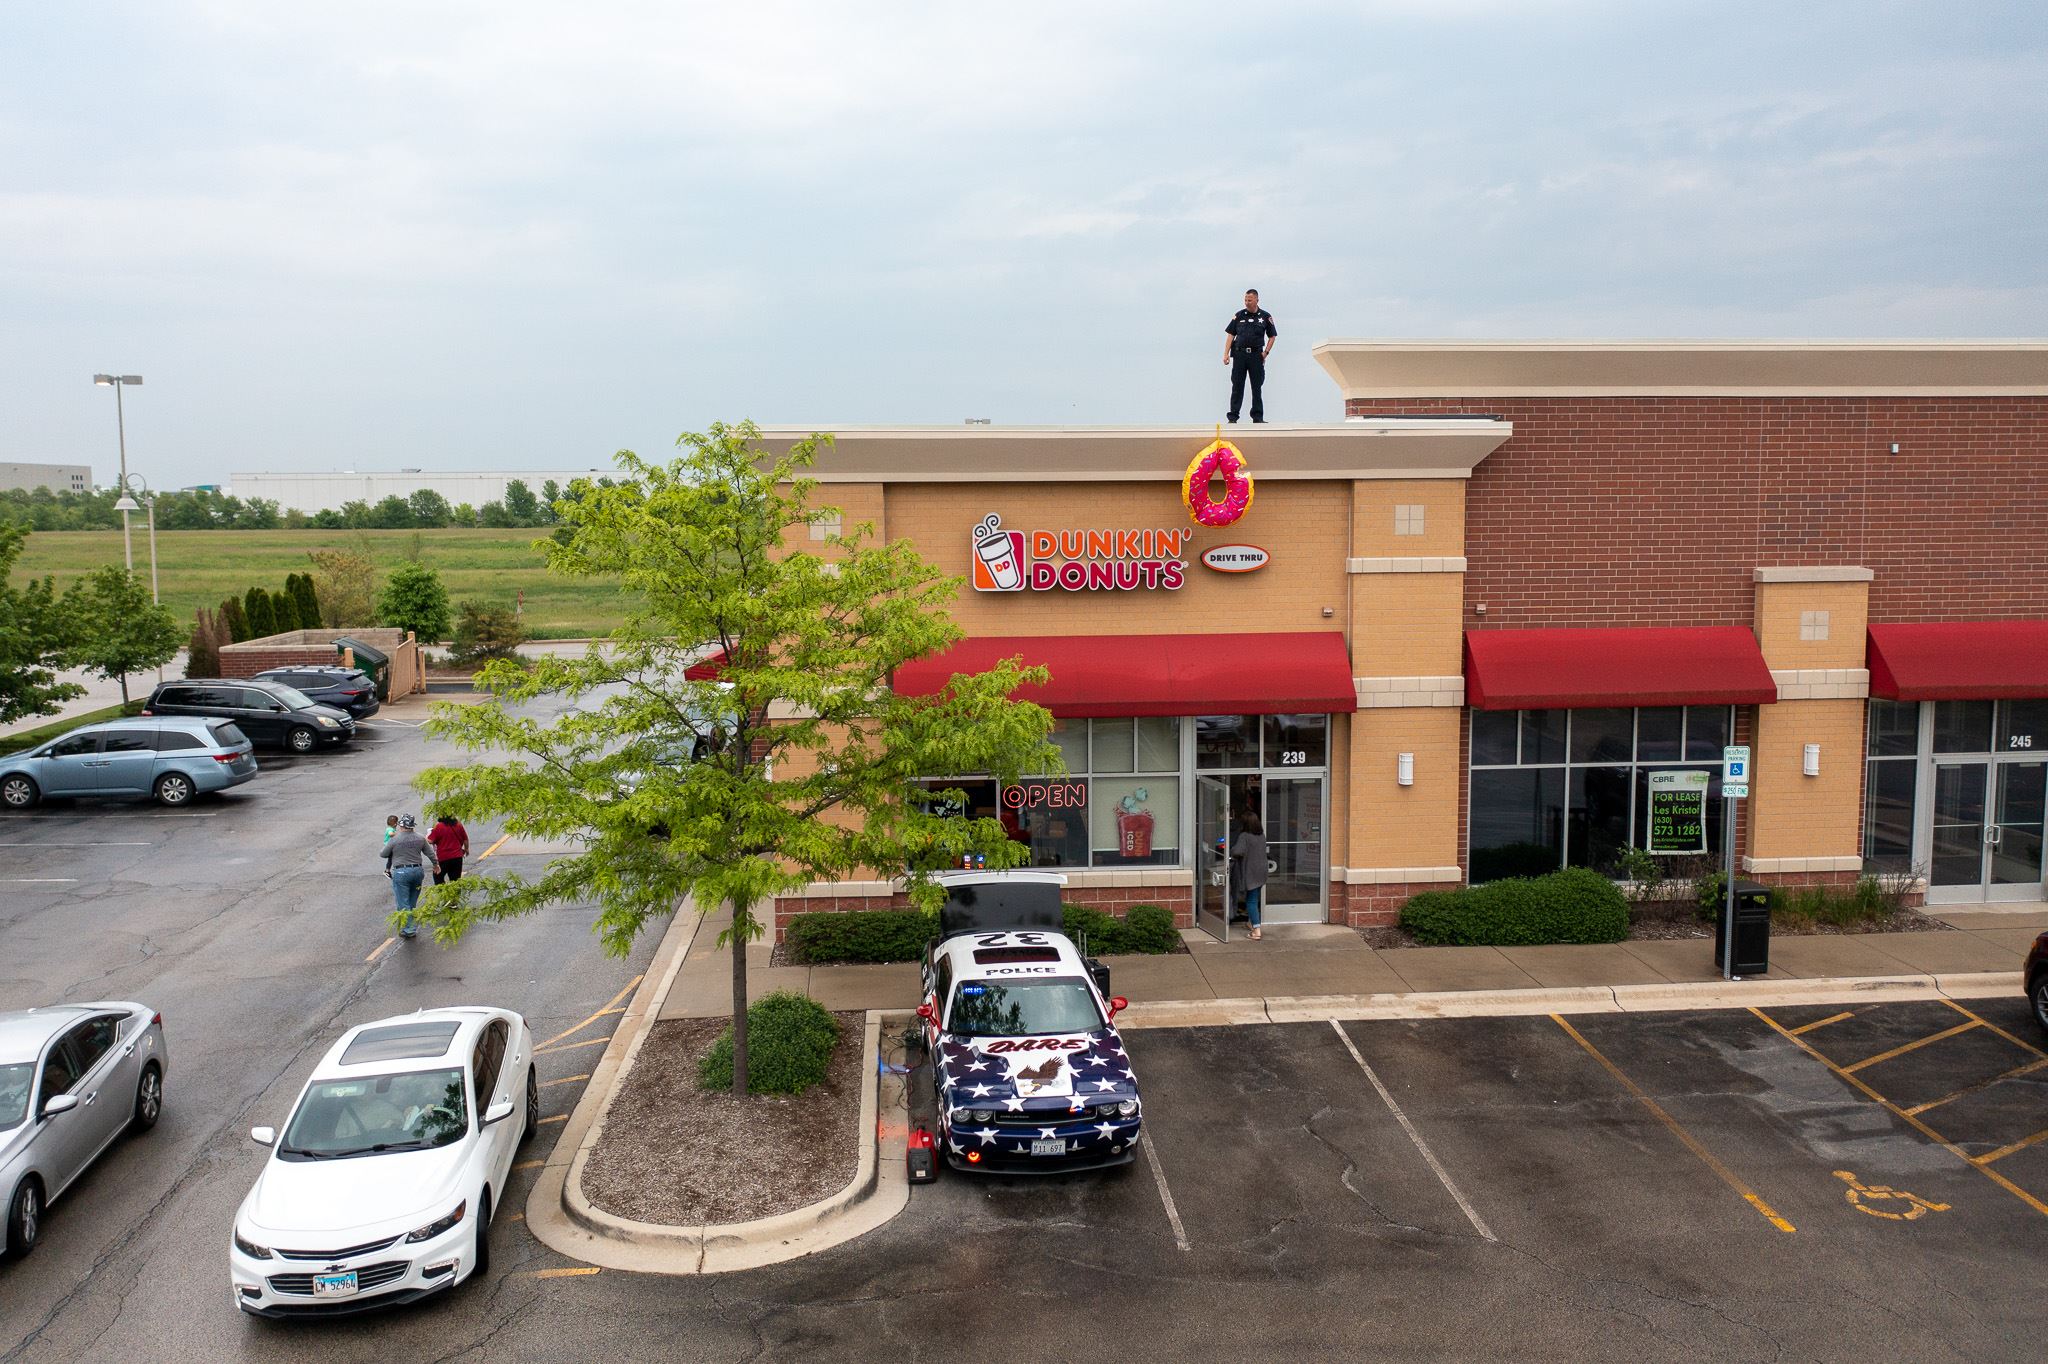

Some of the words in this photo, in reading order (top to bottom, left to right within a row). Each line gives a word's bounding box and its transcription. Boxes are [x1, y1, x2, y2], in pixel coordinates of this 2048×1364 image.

[1032, 528, 1192, 560] DUNKIN'
[1210, 554, 1237, 562] DRIVE
[1240, 554, 1263, 562] THRU
[1032, 560, 1185, 591] DONUTS
[2010, 735, 2032, 748] 245
[1282, 751, 1306, 764] 239
[1653, 775, 1675, 783] CBRE
[1003, 783, 1086, 809] OPEN
[1655, 793, 1673, 802] FOR
[1676, 792, 1700, 802] LEASE
[1654, 805, 1670, 815] Les
[1654, 816, 1673, 825] (630)
[1654, 825, 1674, 836] 573
[1677, 825, 1701, 836] 1282
[1135, 830, 1145, 856] DUN
[986, 967, 1057, 976] POLICE
